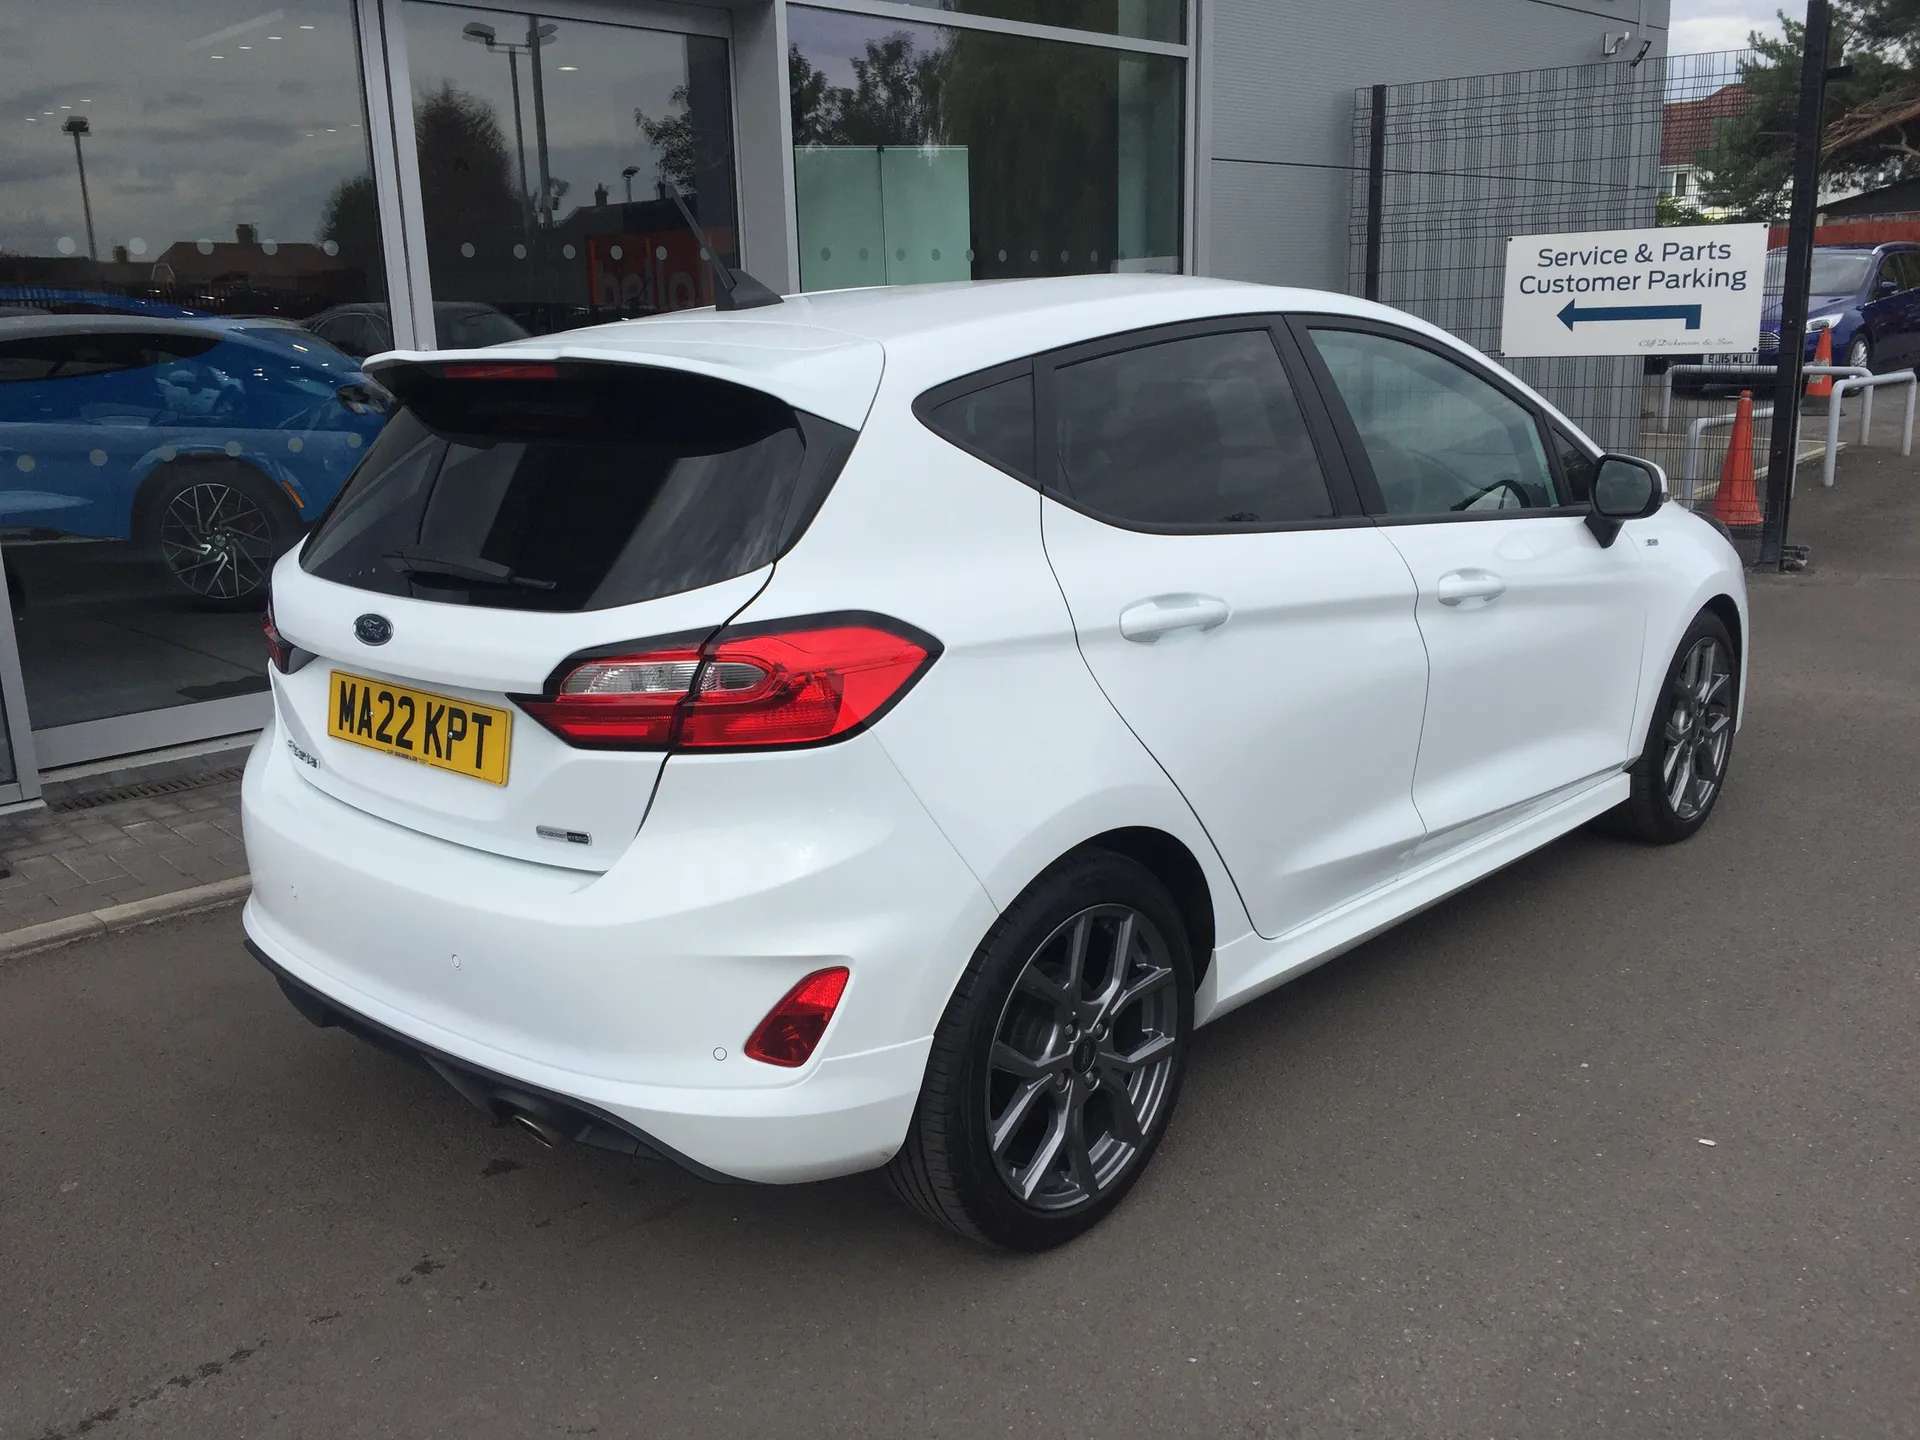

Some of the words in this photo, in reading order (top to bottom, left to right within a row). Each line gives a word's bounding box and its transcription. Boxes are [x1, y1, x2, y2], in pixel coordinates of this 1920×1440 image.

[1537, 246, 1627, 267] Service
[1634, 243, 1653, 263] &
[1662, 240, 1731, 261] Parts
[1520, 274, 1641, 294] Customer
[1648, 268, 1747, 291] Parking
[338, 680, 415, 750] MA22
[424, 701, 493, 769] KPT
